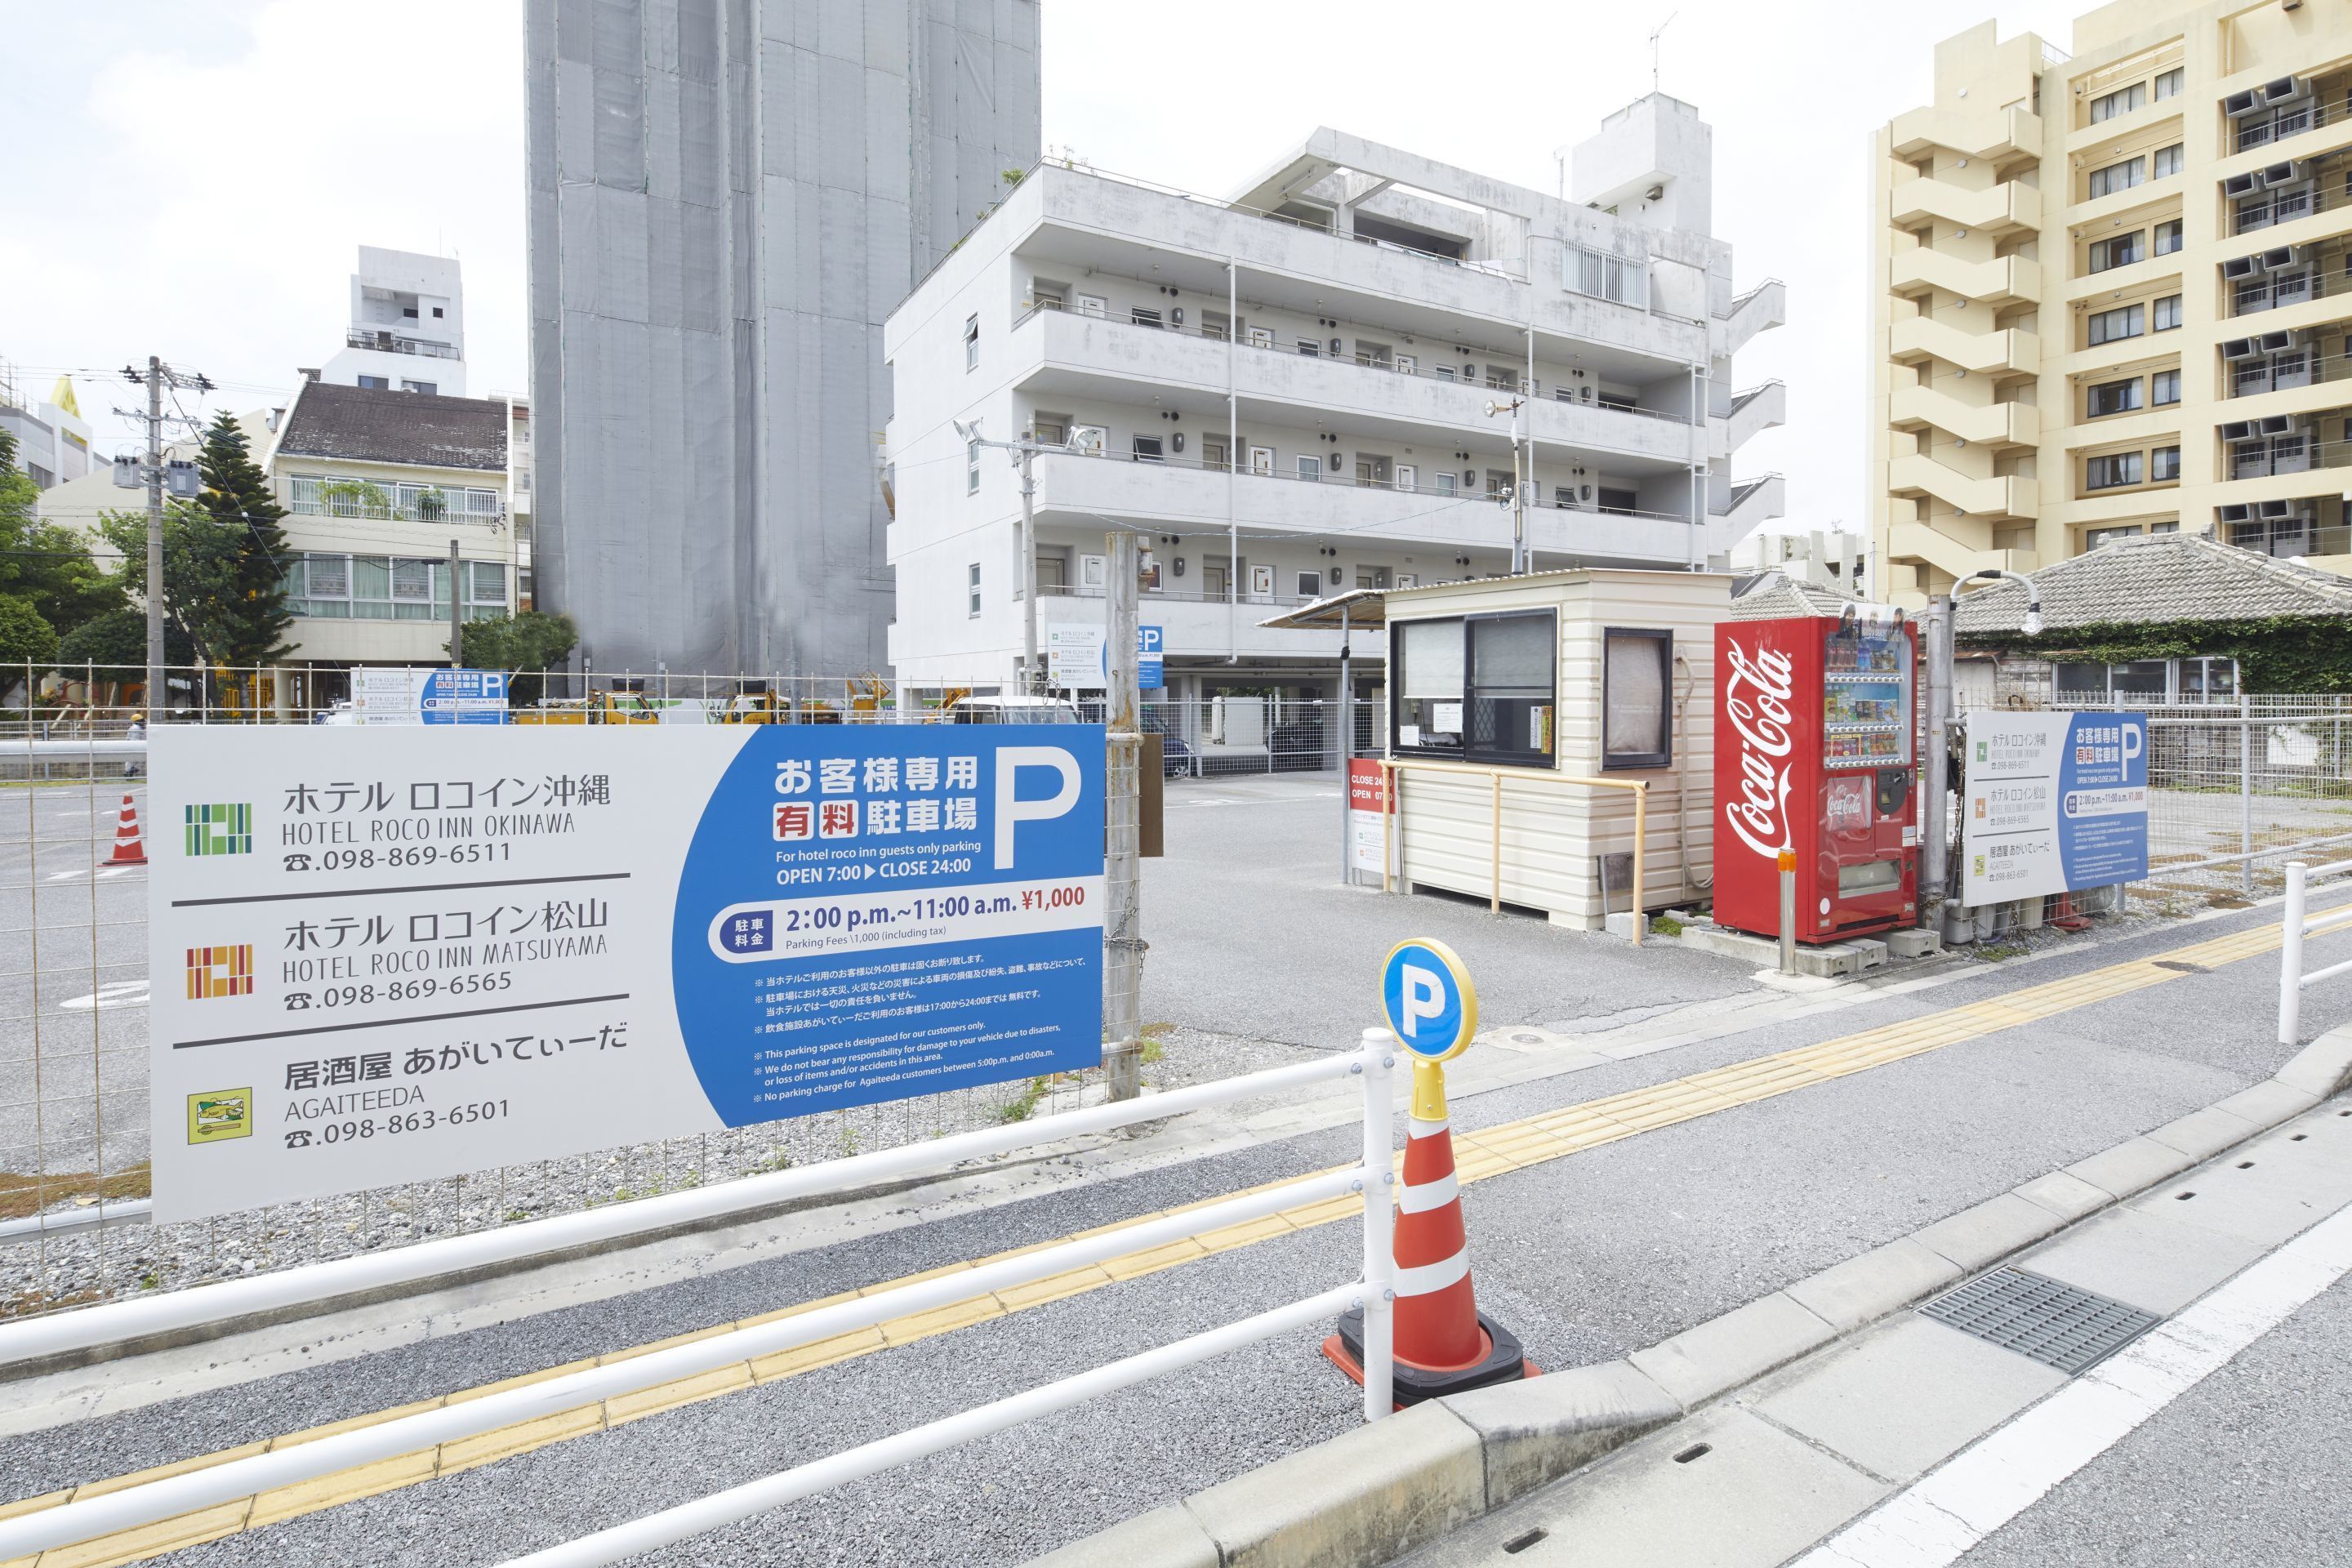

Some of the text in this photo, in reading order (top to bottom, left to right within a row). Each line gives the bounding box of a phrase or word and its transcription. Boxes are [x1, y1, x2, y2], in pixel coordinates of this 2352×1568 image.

[1145, 630, 1159, 651] P
[483, 674, 503, 697] P
[1726, 637, 1793, 859] Coca-Cola
[1992, 734, 2009, 747] ホテル
[2077, 724, 2141, 781] お客様専用 P
[283, 774, 611, 814] ホテル ロコイン沖縄
[1352, 774, 1374, 785] CLOSE
[1352, 789, 1371, 799] OPEN
[1990, 789, 2008, 803] ホテル
[774, 746, 1082, 870] お客様専用 P
[775, 797, 978, 839] 有料駐車場
[283, 813, 575, 845] HOTEL ROCO INN OKINAWA
[776, 840, 982, 862] For hotel roco inn guests only parking
[777, 858, 972, 885] OPEN 7:00 CLOSE 24:00
[973, 897, 1017, 915] a.m.
[1021, 886, 1085, 911] ¥1,000
[283, 898, 608, 951] ホテル ロコイン松山
[786, 938, 824, 950] Parking
[826, 936, 848, 946] Fees
[881, 928, 928, 942] (including
[929, 925, 947, 936] tax)
[283, 934, 608, 983] HOTEL ROCO INN MATSUYAMA
[1402, 964, 1446, 1038] P
[284, 1022, 627, 1090] 居酒屋 あがいてぃーだ
[764, 1021, 986, 1059] This parking space is designated for our customers only.
[764, 1065, 780, 1074] We
[781, 1062, 793, 1072] do
[794, 1061, 809, 1070] not
[810, 1058, 831, 1067] bear
[831, 1056, 848, 1065] any
[849, 1047, 903, 1062] responsibility
[903, 1045, 916, 1054] for
[916, 1041, 949, 1052] damage
[959, 1037, 977, 1047] your
[977, 1031, 1004, 1043] vehicle
[1004, 1030, 1019, 1039] due
[1028, 1025, 1061, 1036] disasters,
[764, 1049, 1055, 1102] No parking charge for Agaiteeda customers between 5:00p.m. and 0:00a.m.
[776, 1076, 793, 1085] loss
[794, 1071, 804, 1082] of
[804, 1071, 829, 1080] items
[830, 1065, 858, 1076] and/or
[859, 1060, 898, 1071] accidents
[898, 1058, 906, 1066] in
[907, 1055, 923, 1064] this
[923, 1054, 943, 1062] area.
[284, 1085, 425, 1121] AGAITEEDA
